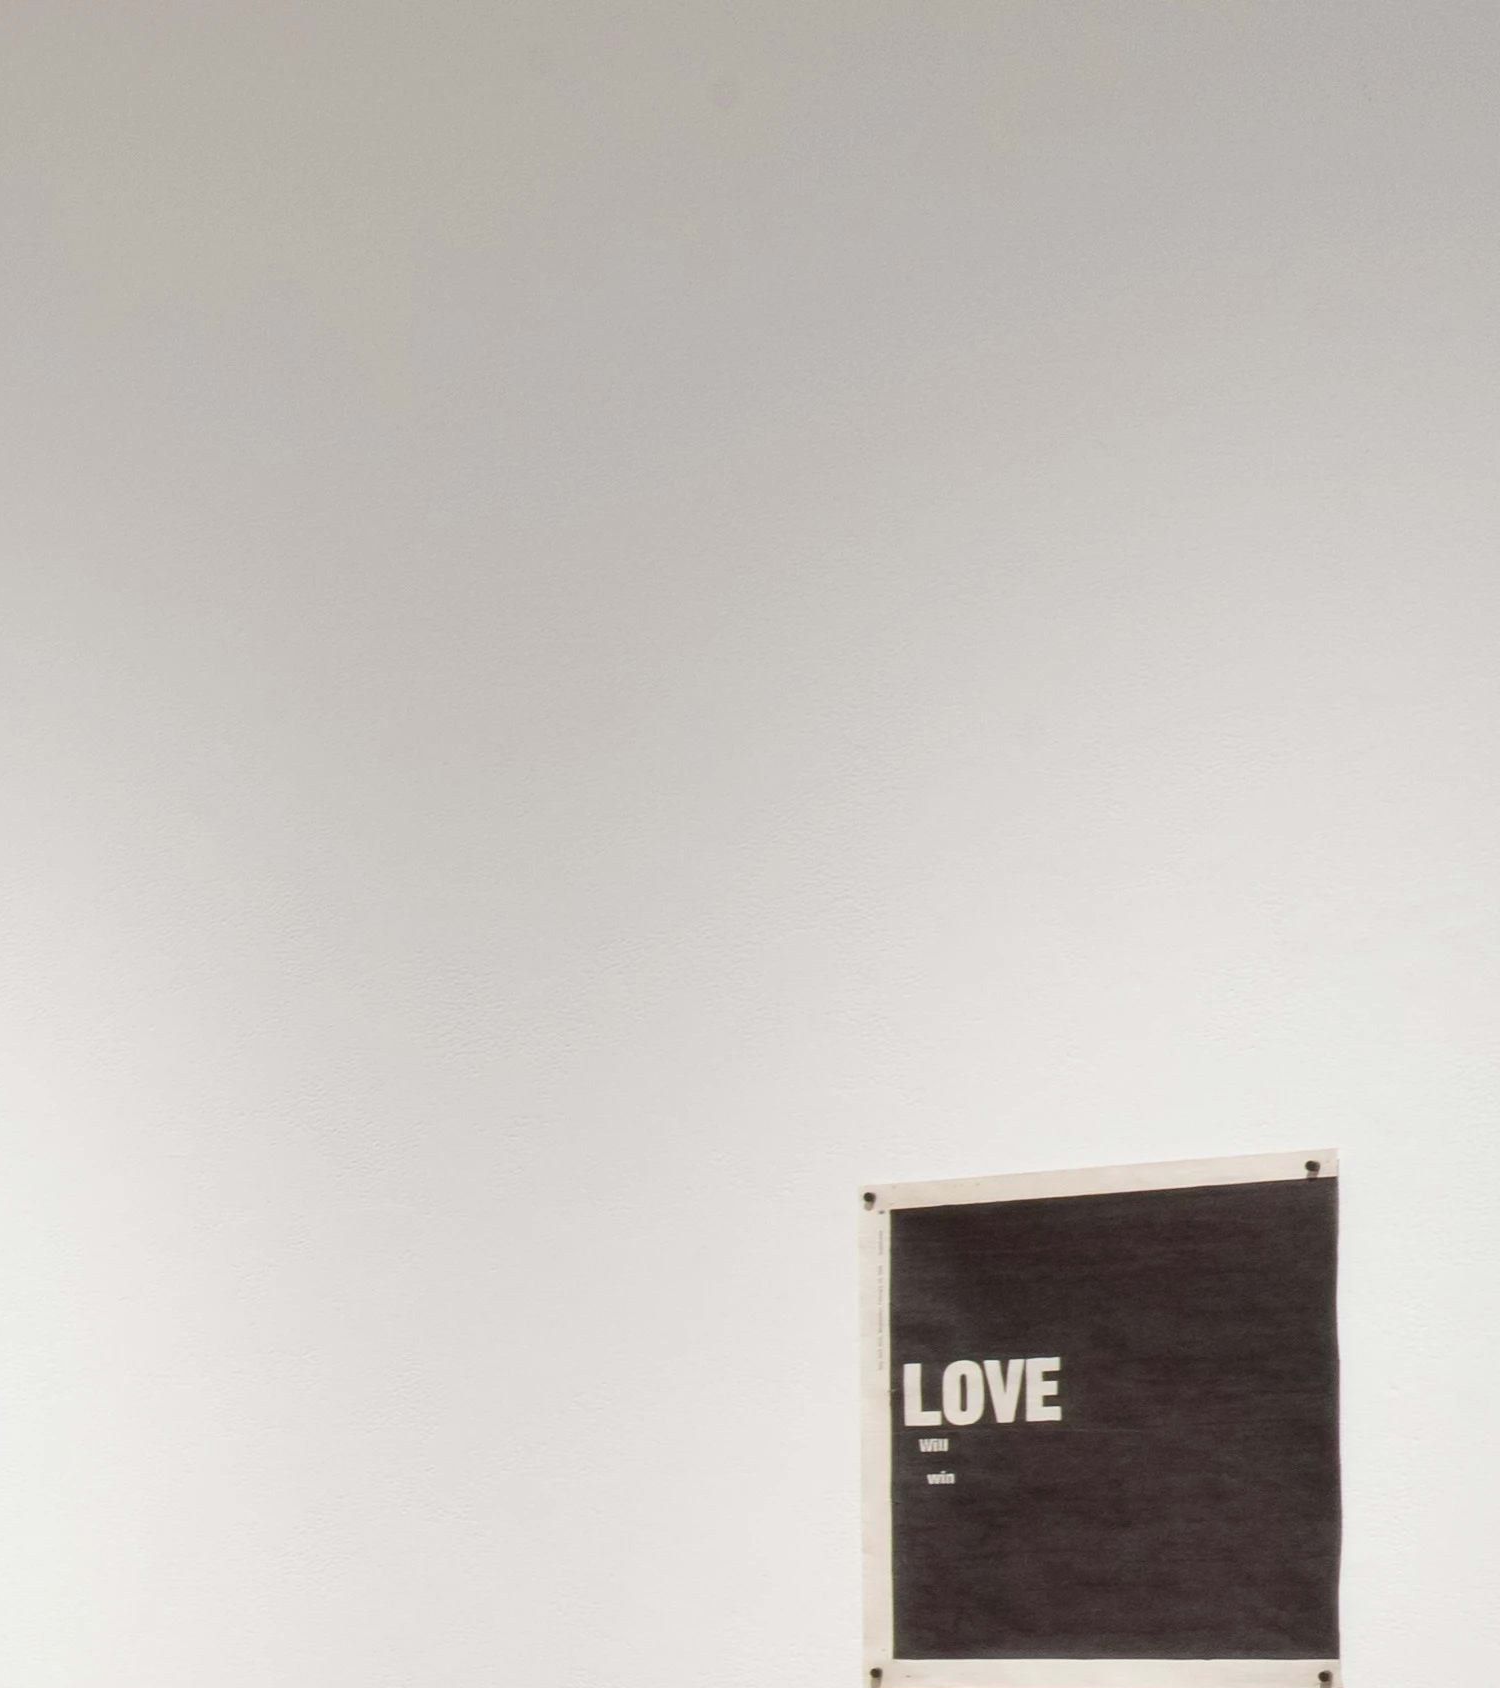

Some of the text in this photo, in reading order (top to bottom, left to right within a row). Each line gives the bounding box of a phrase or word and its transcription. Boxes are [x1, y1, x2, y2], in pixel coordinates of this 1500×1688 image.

[903, 1356, 1062, 1426] LOVE
[918, 1438, 949, 1452] will
[926, 1470, 956, 1484] win
